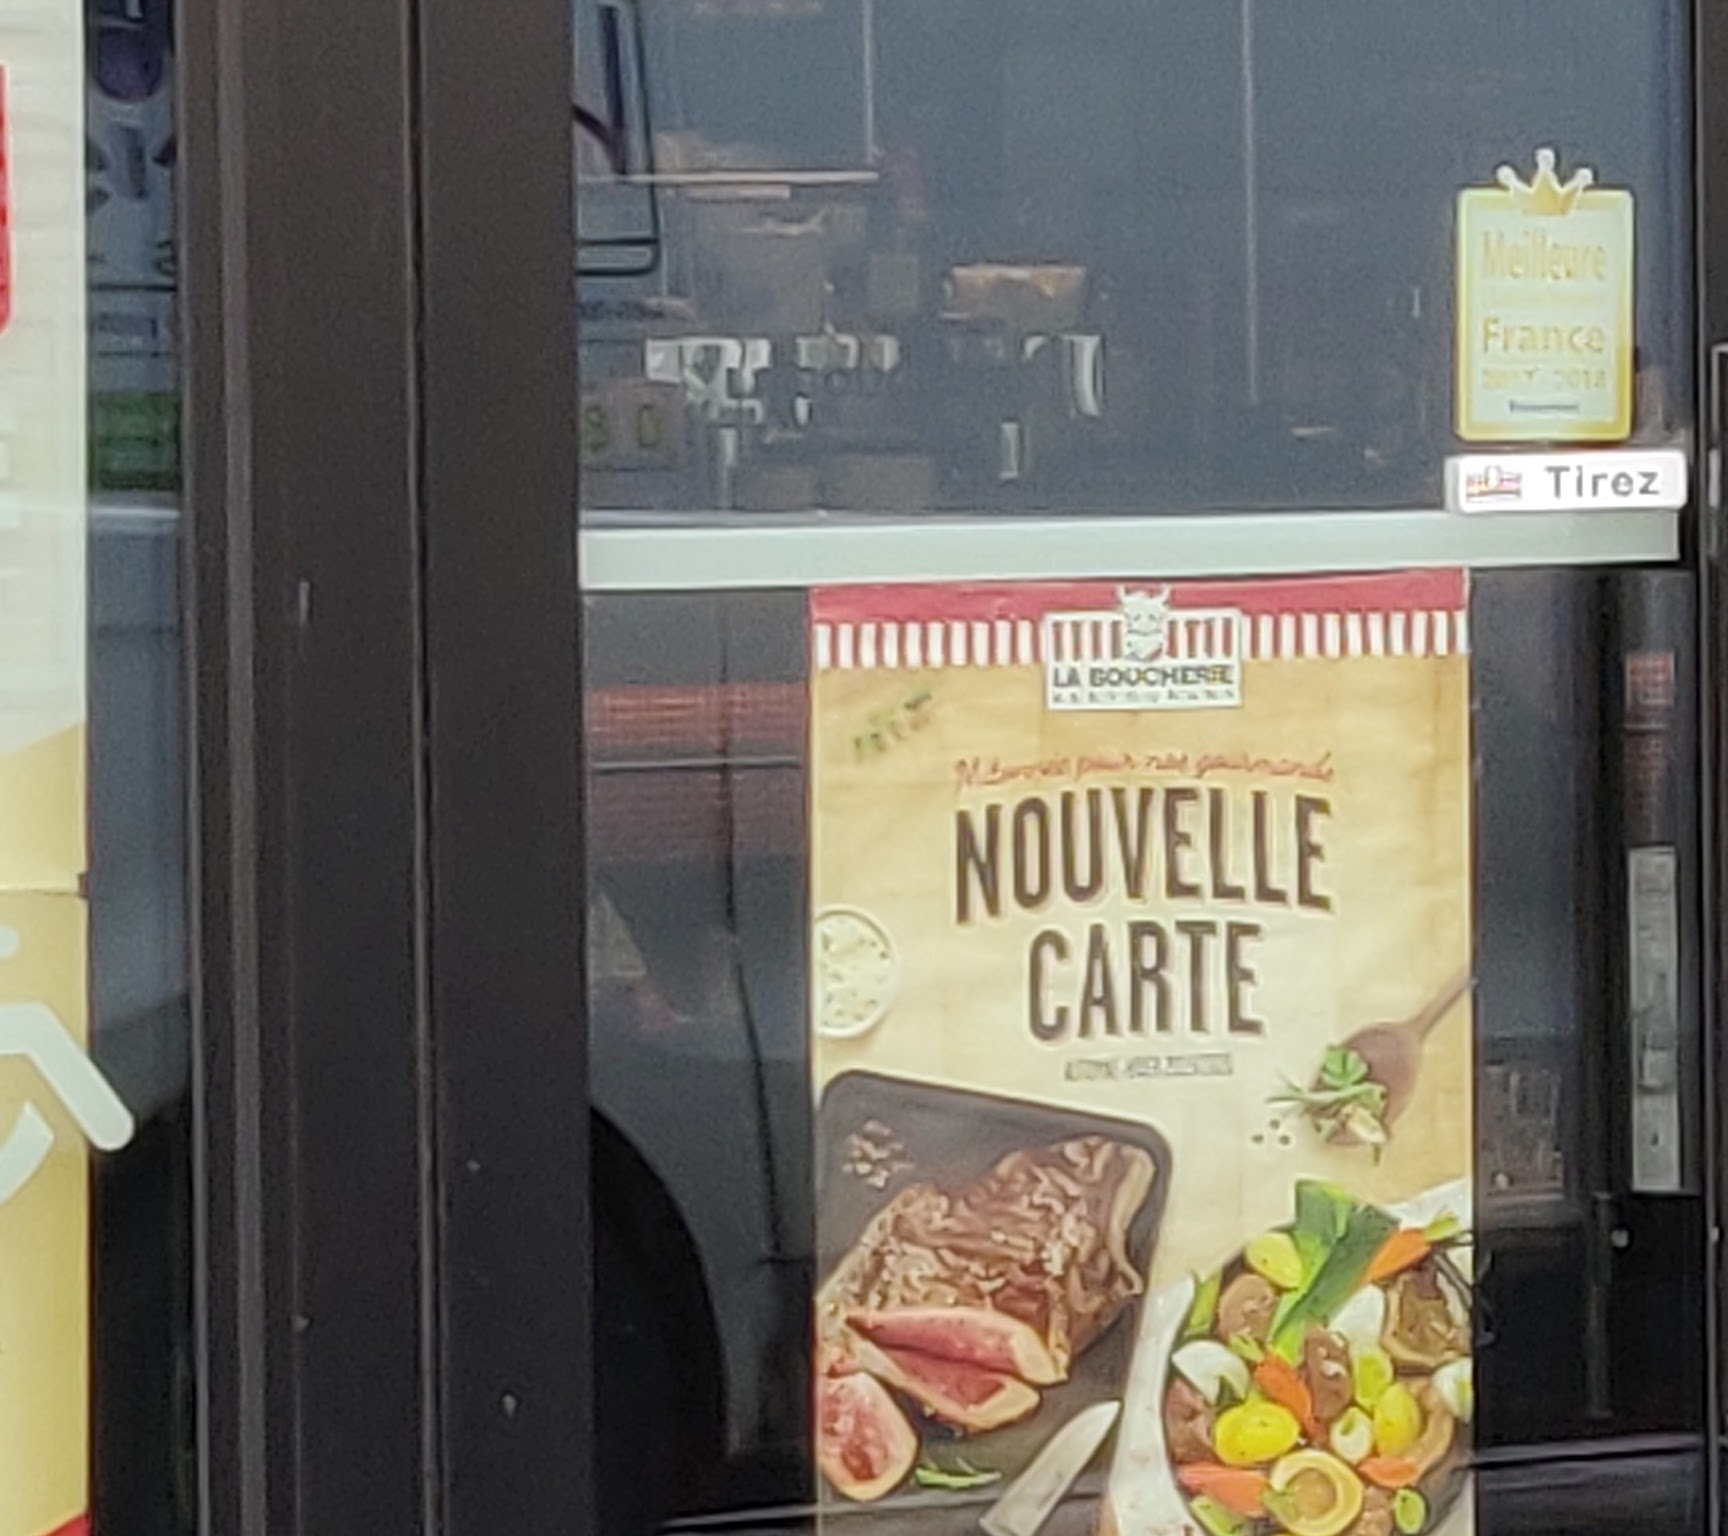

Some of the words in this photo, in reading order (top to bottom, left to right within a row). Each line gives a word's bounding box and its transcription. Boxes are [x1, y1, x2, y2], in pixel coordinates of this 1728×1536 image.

[1482, 316, 1606, 356] France
[1544, 465, 1661, 499] Tirez
[1052, 667, 1082, 688] LA
[955, 786, 1335, 924] NOUVELLE
[1028, 920, 1263, 1042] CARTE
